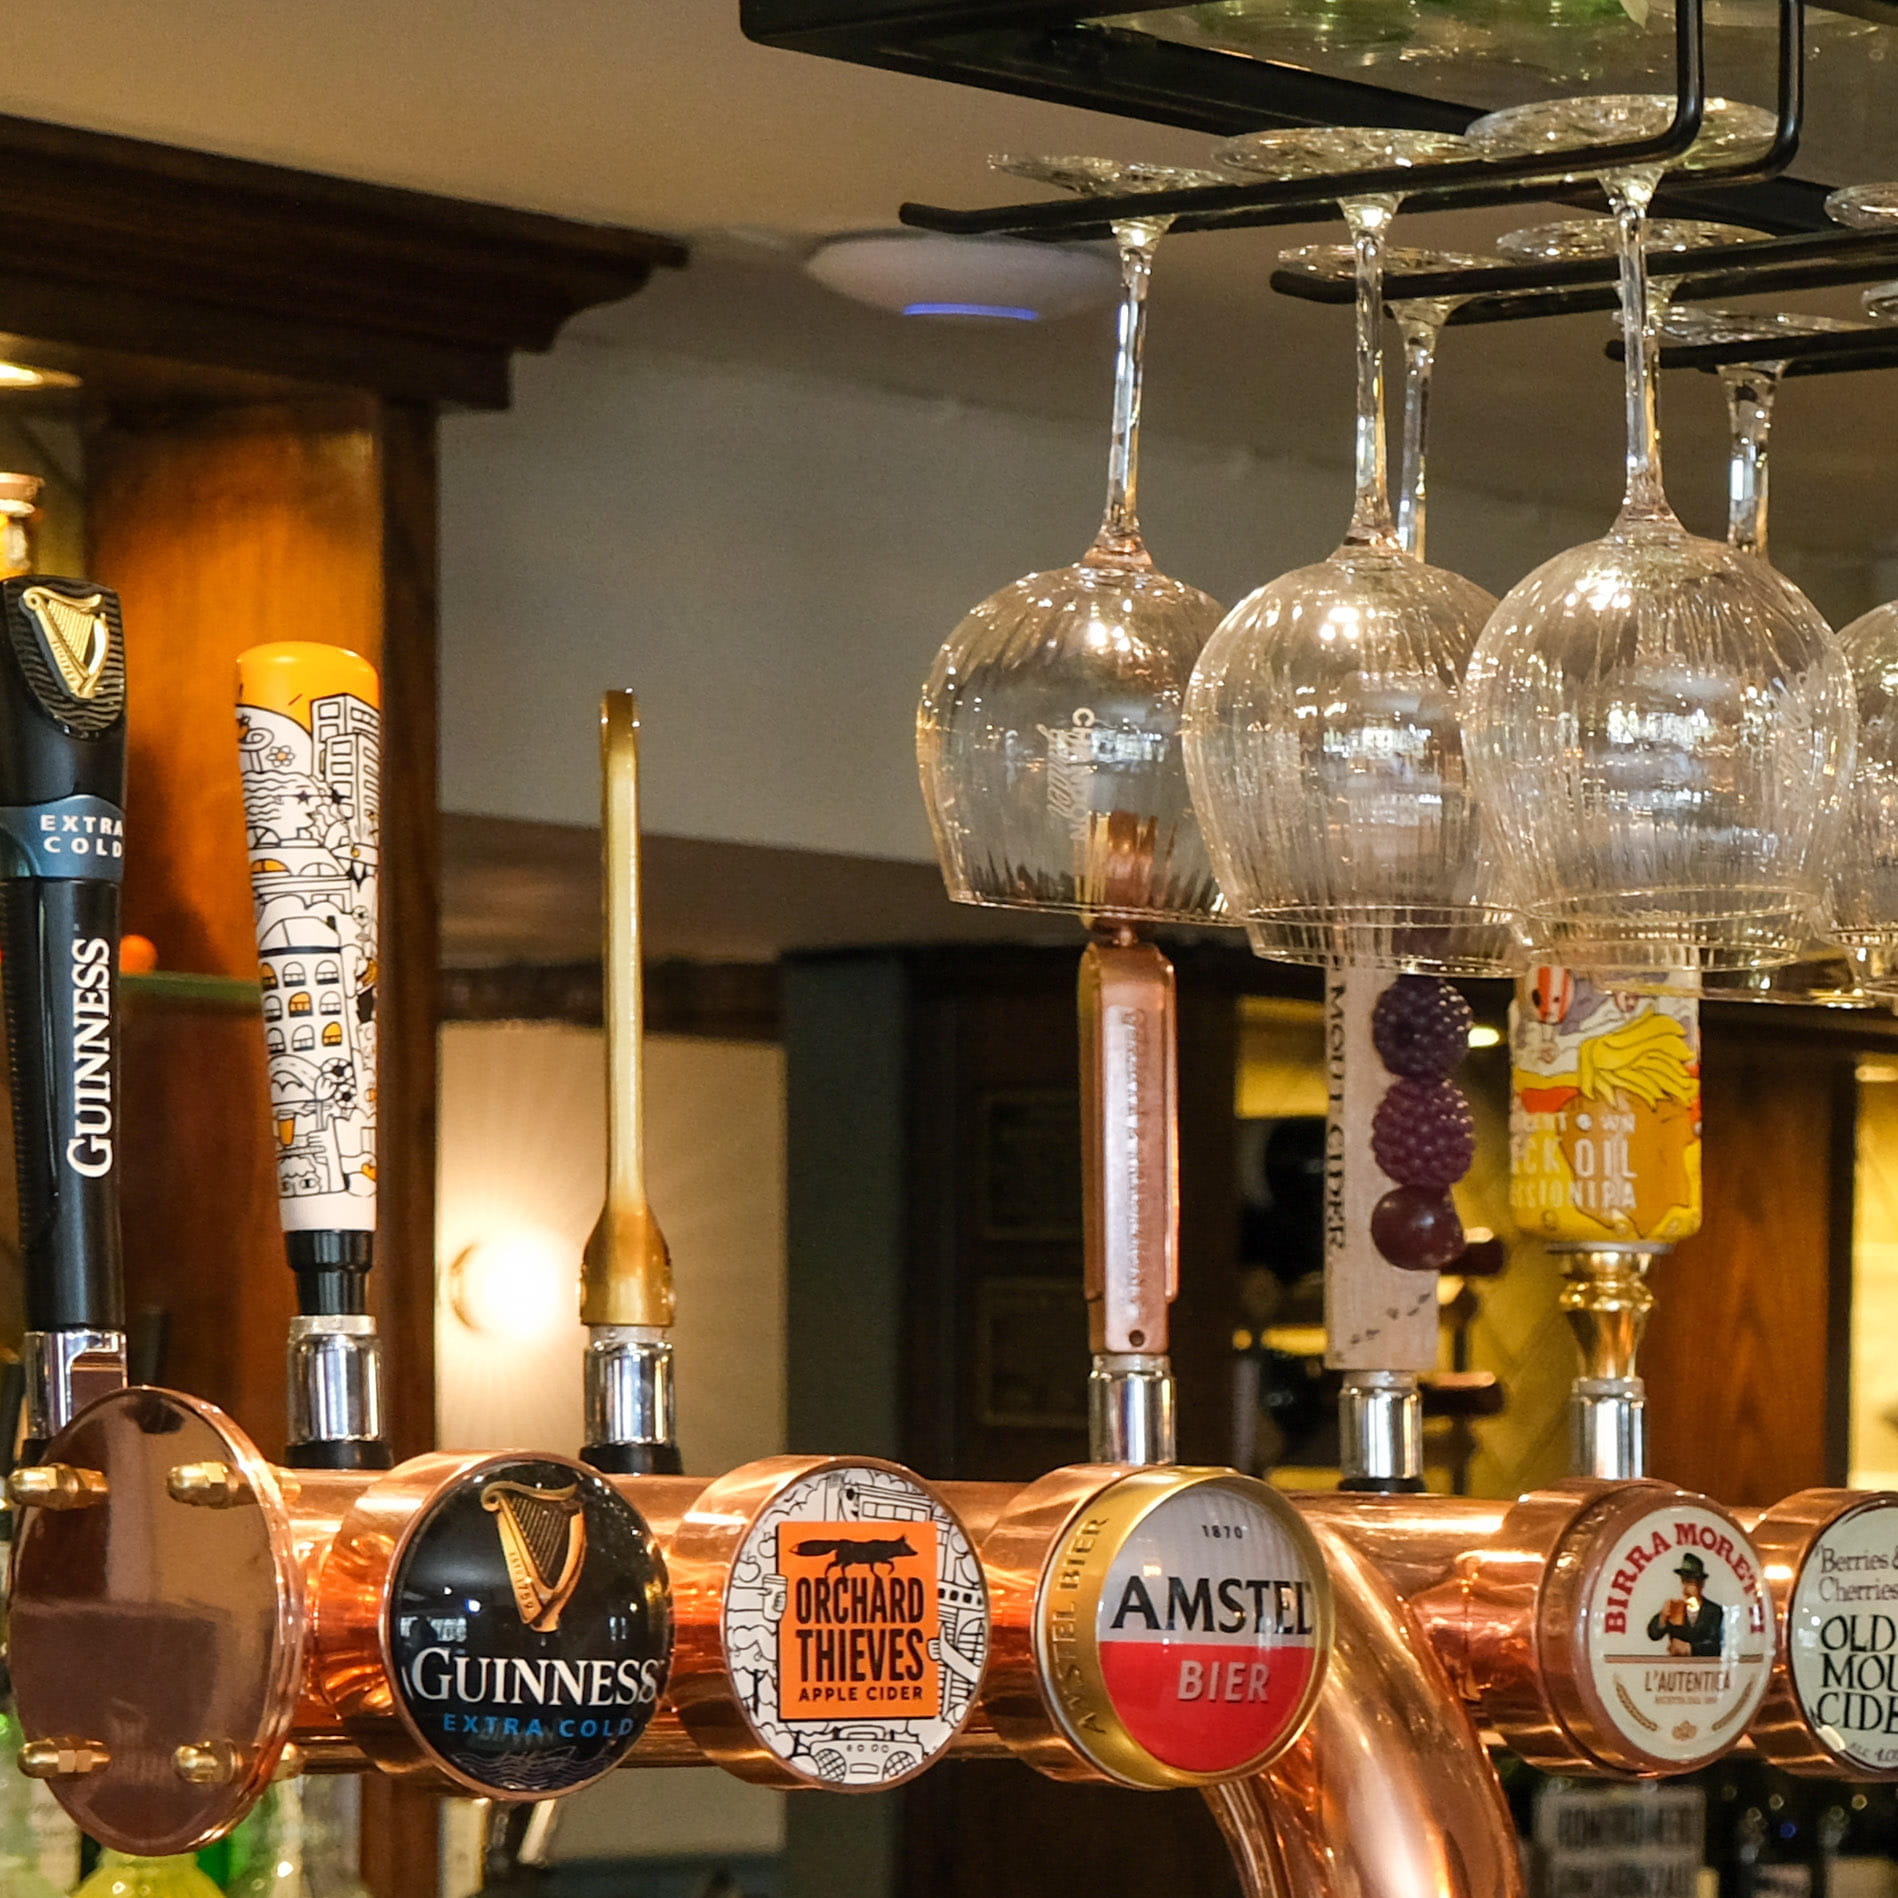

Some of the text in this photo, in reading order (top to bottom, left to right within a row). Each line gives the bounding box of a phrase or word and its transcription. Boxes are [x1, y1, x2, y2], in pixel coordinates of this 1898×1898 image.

[40, 814, 123, 837] EXTRA
[43, 836, 122, 858] COLD
[66, 938, 113, 1178] GUINNESS
[1202, 1524, 1244, 1540] 1870
[1819, 1547, 1889, 1574] Berries
[796, 1577, 924, 1624] ORCHARD
[1604, 1531, 1673, 1634] BIRRA
[1051, 1517, 1109, 1735] AMSTEL BIER
[1110, 1575, 1313, 1635] AMSTEL
[796, 1628, 924, 1682] THIEVES
[1820, 1614, 1896, 1653] OLD
[411, 1647, 658, 1707] GUINNESS
[799, 1686, 923, 1702] APPLE CIDER
[1177, 1660, 1270, 1703] BIER
[443, 1714, 635, 1738] EXTRA COLD
